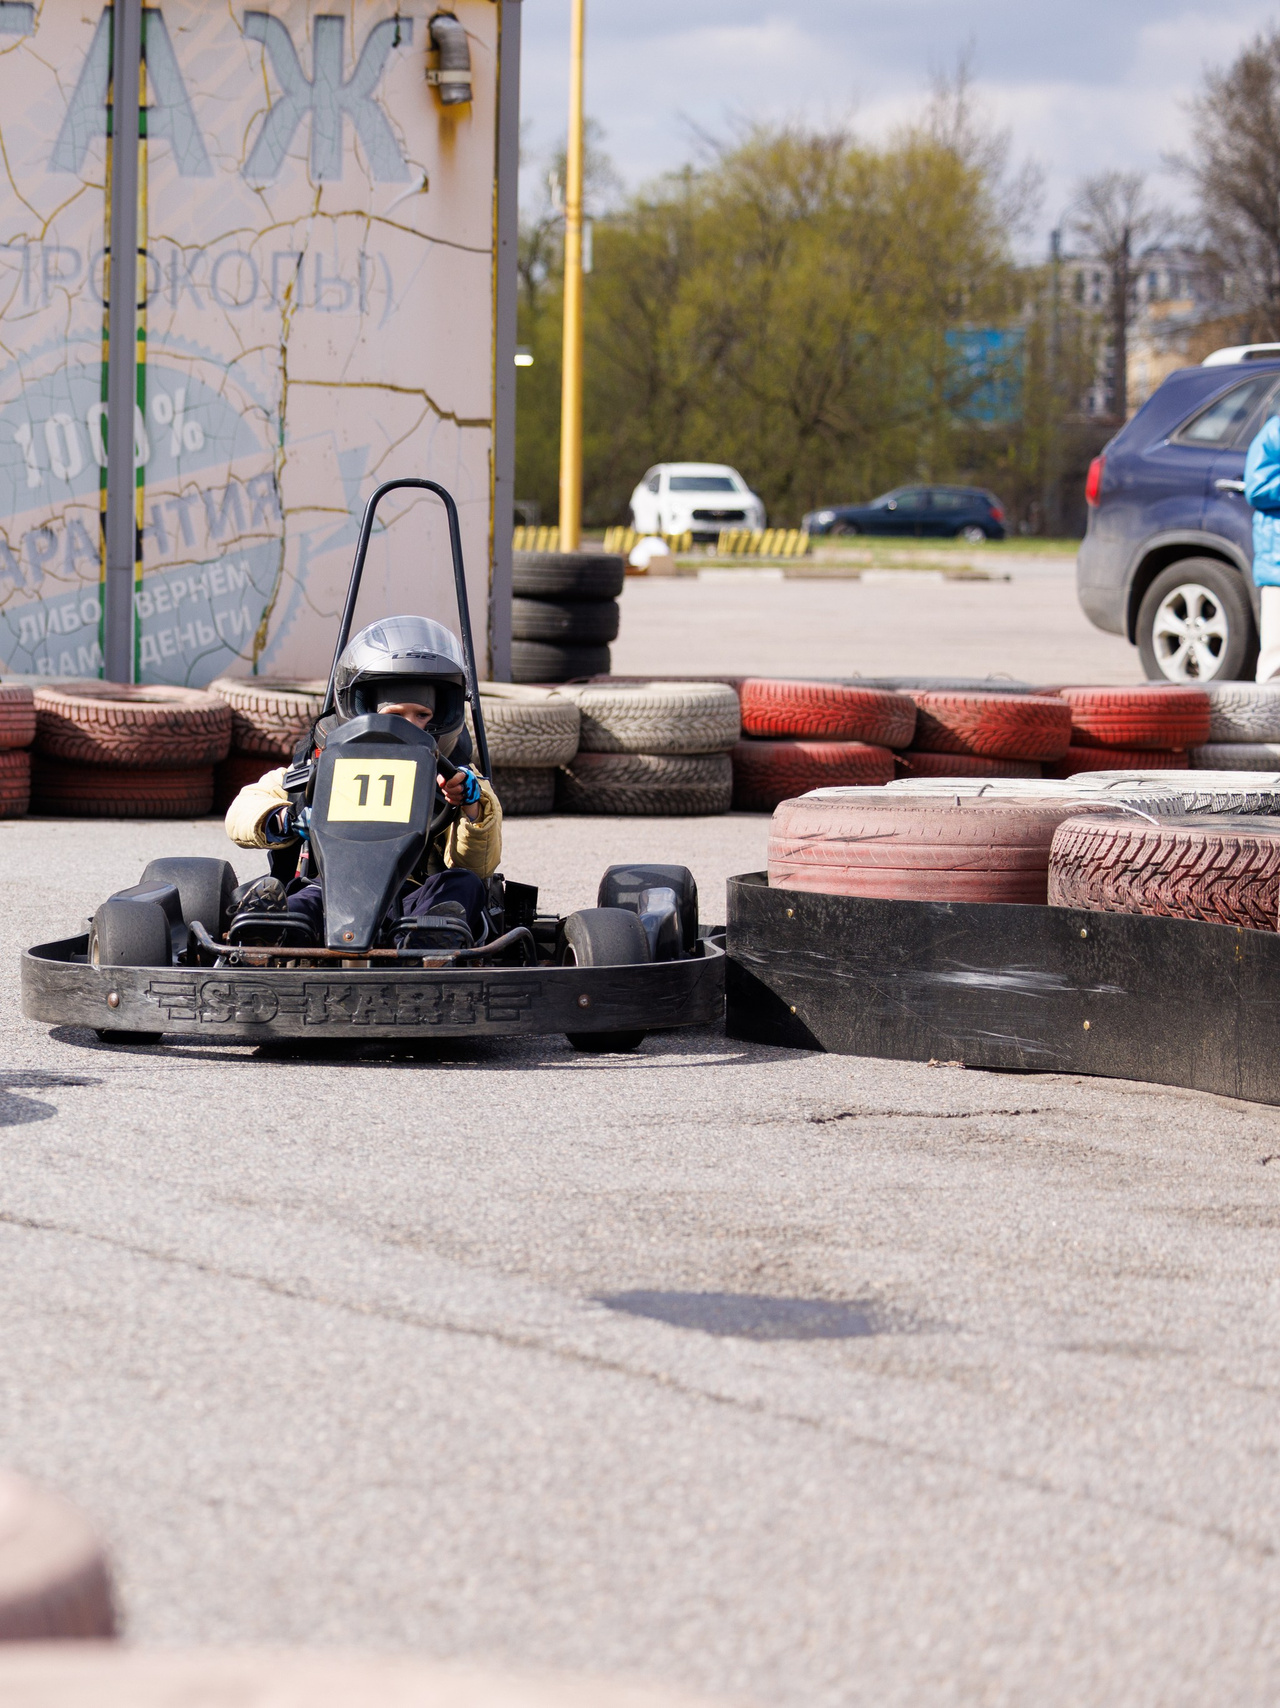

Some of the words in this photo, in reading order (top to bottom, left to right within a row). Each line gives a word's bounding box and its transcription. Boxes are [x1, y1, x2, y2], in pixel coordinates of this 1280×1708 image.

[18, 597, 102, 646] ЛИБО
[36, 640, 105, 677] ВАМ
[138, 606, 252, 671] ДЕНЬГИ
[391, 651, 437, 662] LS2
[353, 774, 396, 806] 11
